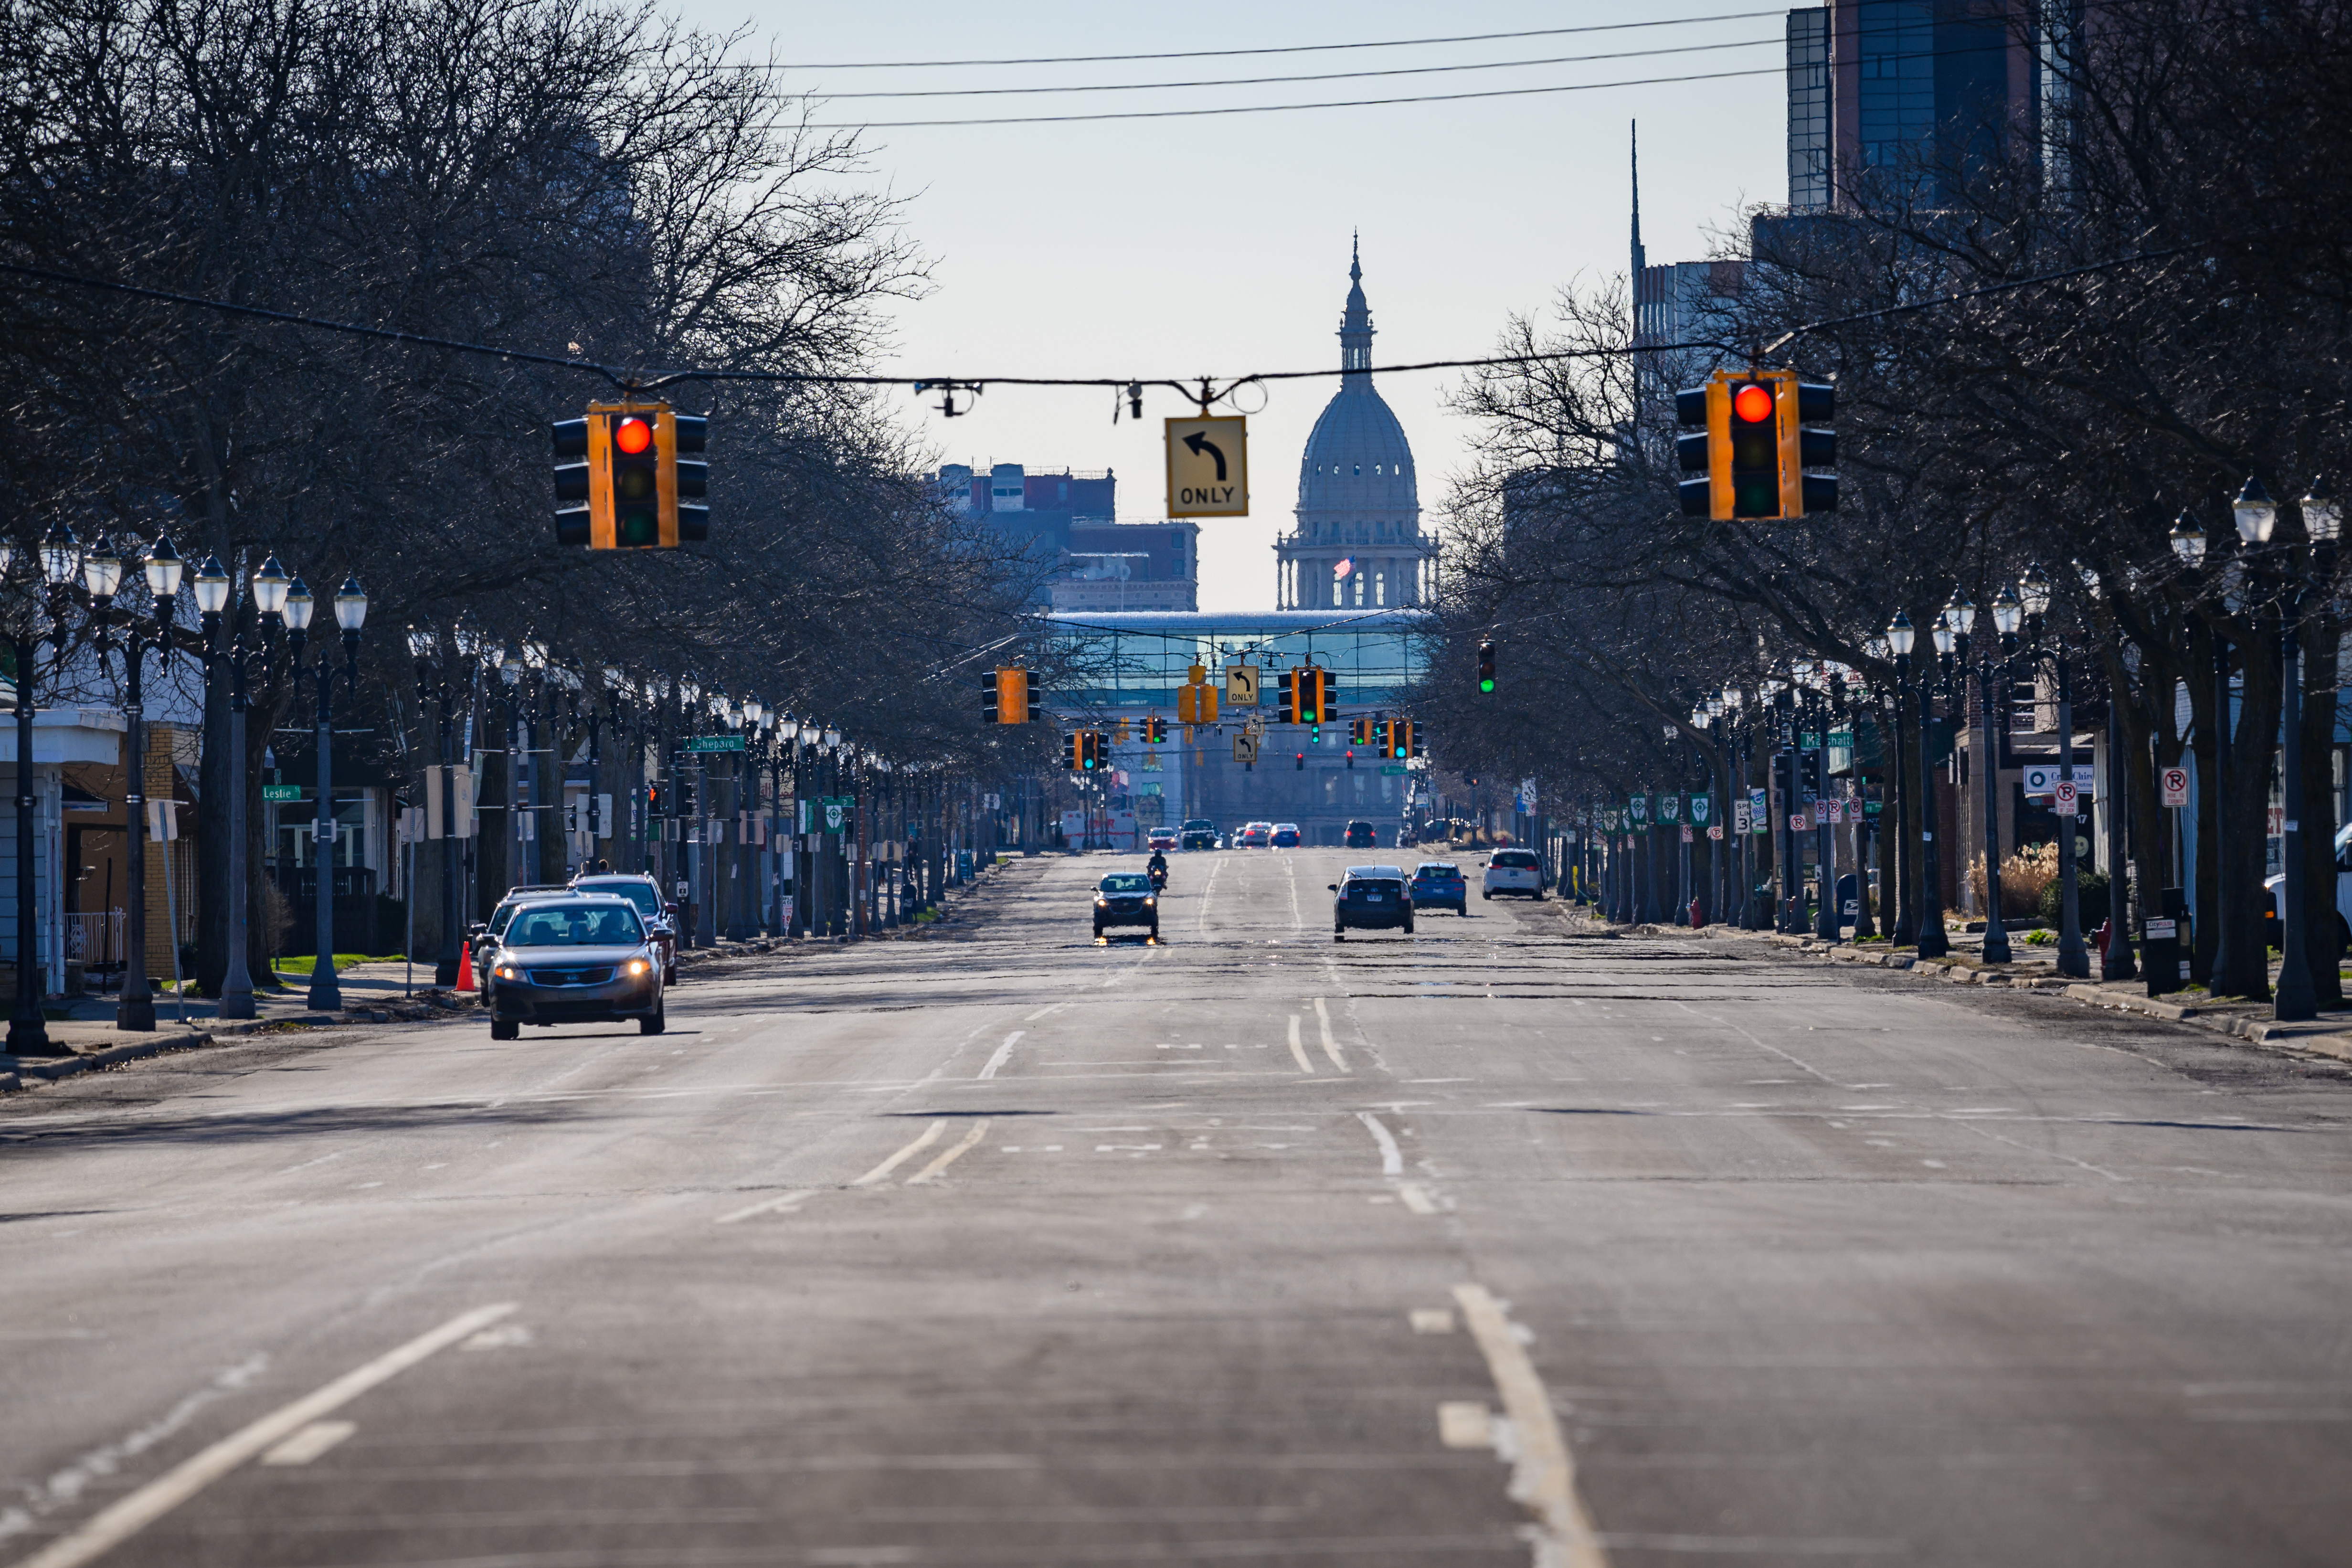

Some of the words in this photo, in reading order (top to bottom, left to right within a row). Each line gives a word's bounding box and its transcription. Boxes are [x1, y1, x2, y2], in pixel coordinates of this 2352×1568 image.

[1181, 486, 1234, 504] ONLY
[1806, 735, 1849, 745] Mashall
[264, 787, 291, 798] Leslie
[1752, 805, 1765, 814] BUS
[1738, 818, 1748, 830] 3
